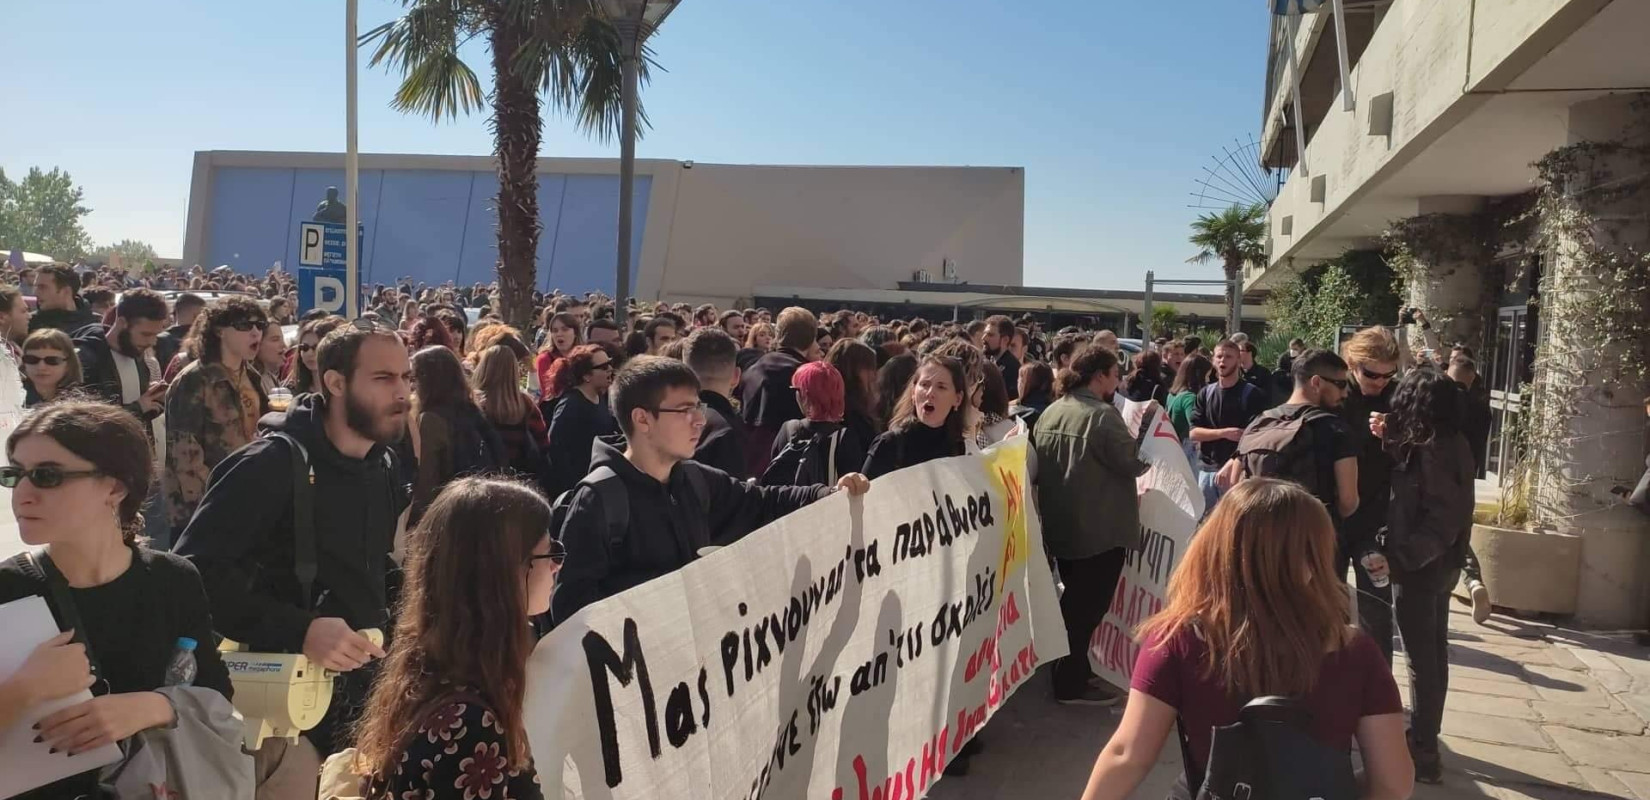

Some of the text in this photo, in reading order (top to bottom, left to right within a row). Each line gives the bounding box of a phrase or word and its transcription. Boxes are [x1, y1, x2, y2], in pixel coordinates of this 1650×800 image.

[305, 228, 319, 260] P
[582, 618, 710, 788] Μας
[893, 491, 994, 565] παράθυρα
